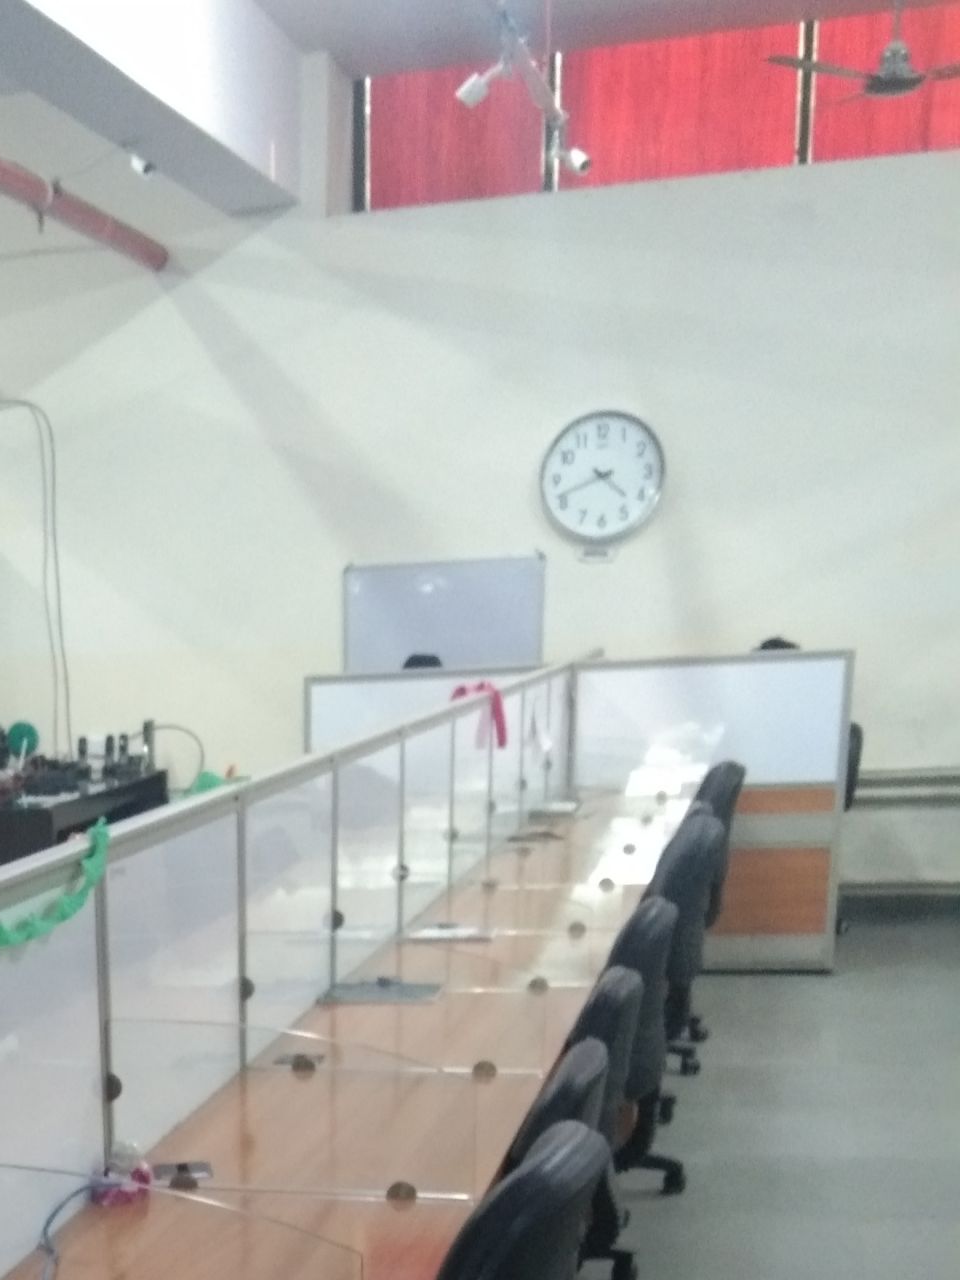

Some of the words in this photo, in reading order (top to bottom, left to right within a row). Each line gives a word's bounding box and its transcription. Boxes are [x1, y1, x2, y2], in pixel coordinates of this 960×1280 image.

[597, 423, 610, 440] 12
[576, 432, 588, 449] 11
[636, 440, 647, 458] 2
[560, 449, 576, 466] 10
[643, 463, 654, 480] 3
[552, 473, 562, 488] 9
[578, 508, 588, 526] 7
[619, 504, 630, 521] 5
[596, 513, 608, 530] 6
